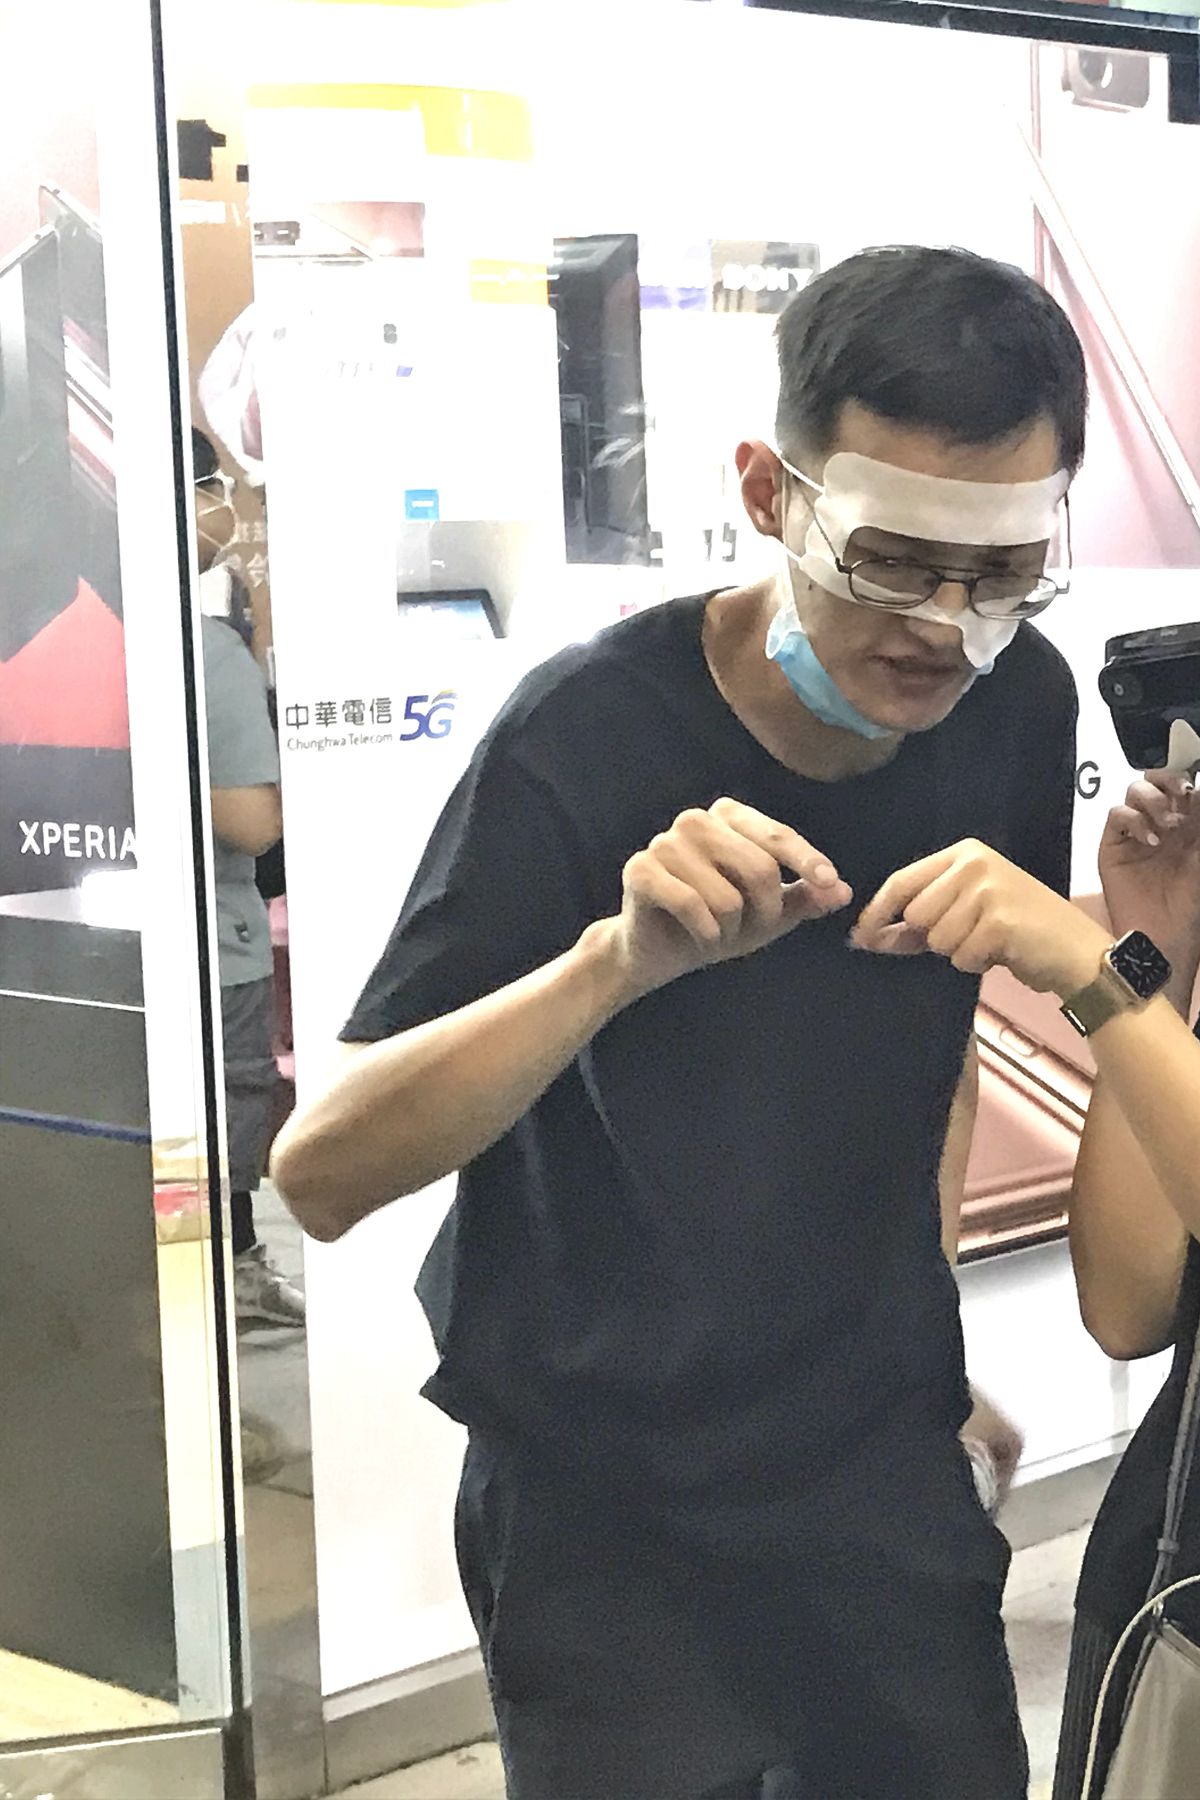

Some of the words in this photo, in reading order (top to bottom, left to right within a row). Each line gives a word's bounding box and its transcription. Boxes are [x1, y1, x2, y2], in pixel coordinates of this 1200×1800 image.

[285, 698, 393, 730] 中華電信
[400, 690, 457, 742] 5G
[287, 737, 346, 752] Chunghwa
[349, 732, 393, 746] Telecom
[18, 820, 137, 861] XPERIA
